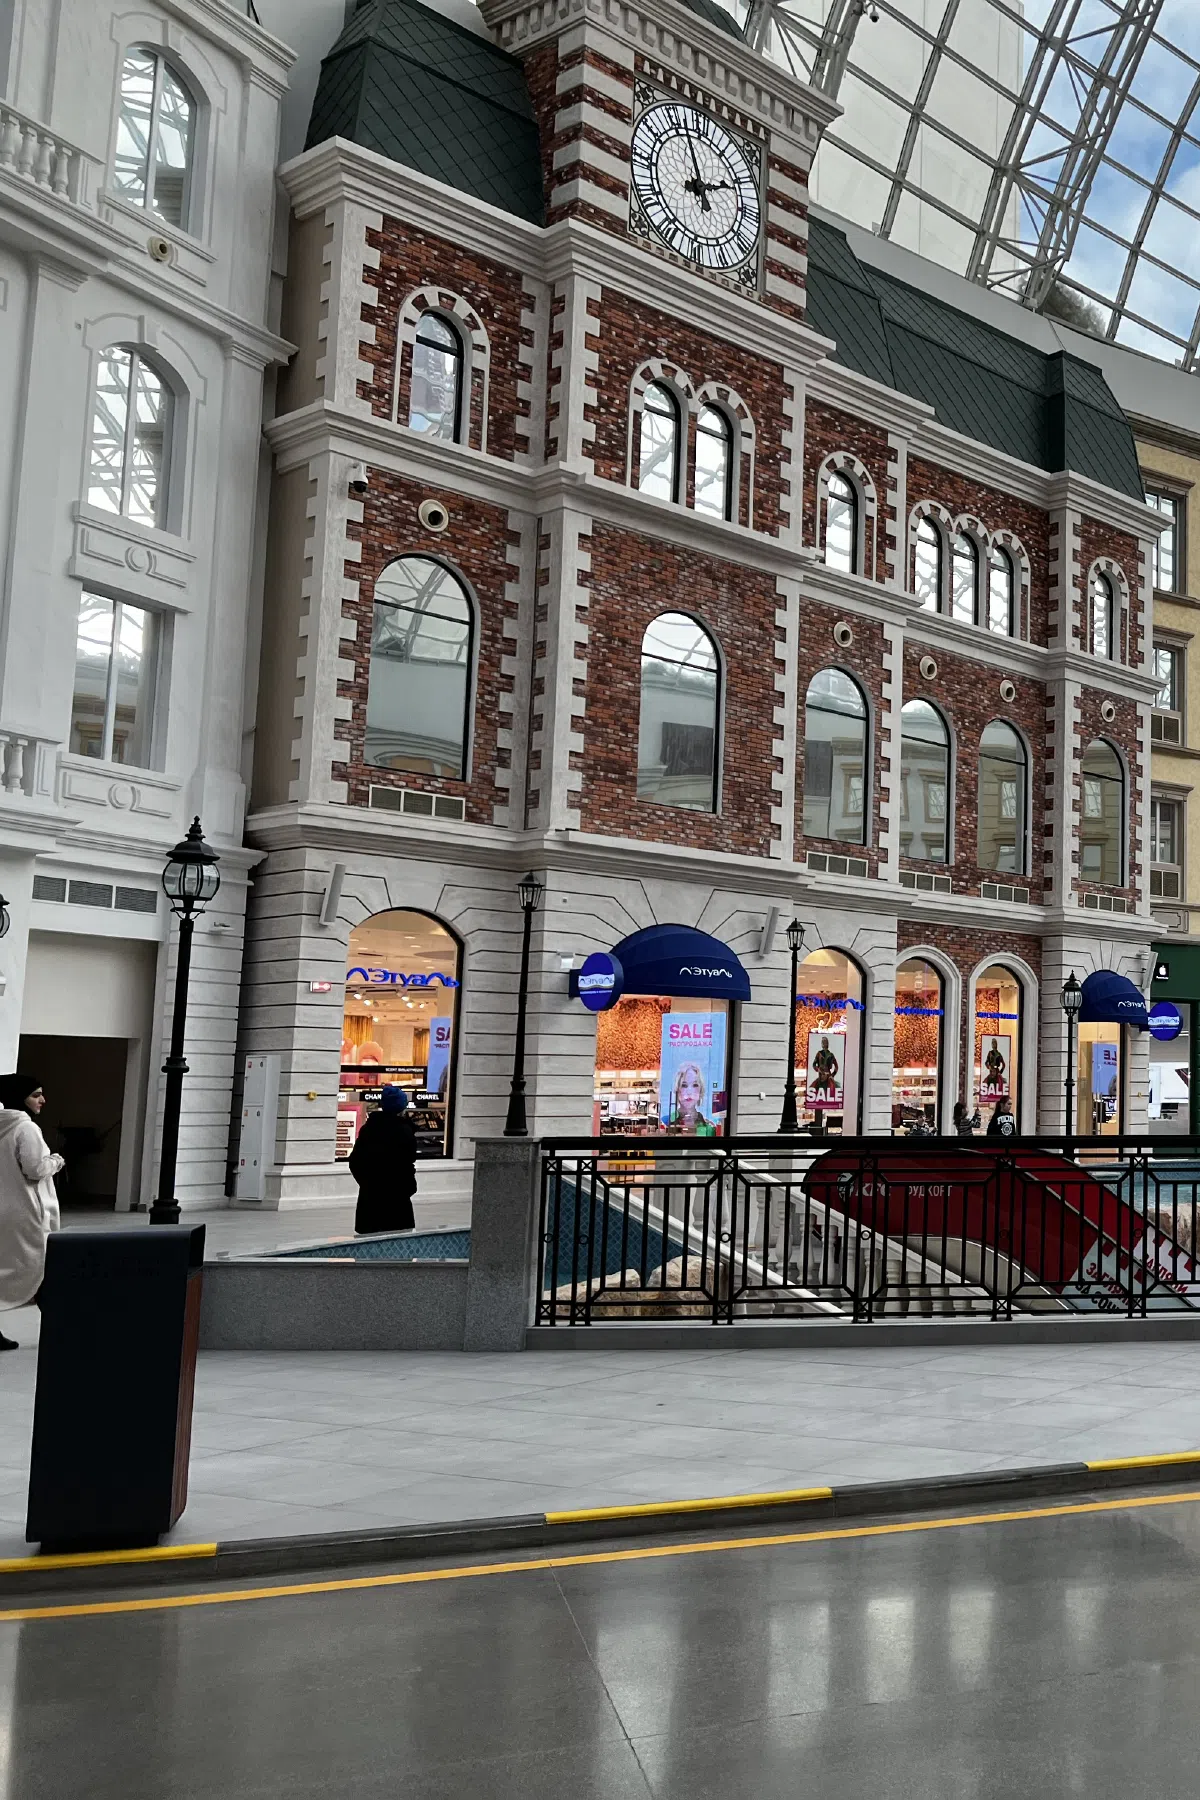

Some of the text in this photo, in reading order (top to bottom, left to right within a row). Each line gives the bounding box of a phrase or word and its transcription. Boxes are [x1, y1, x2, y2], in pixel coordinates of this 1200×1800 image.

[669, 1023, 712, 1039] SALE
[364, 1092, 382, 1100] CHAN
[806, 1087, 843, 1102] SALE
[980, 1082, 1010, 1096] SALE
